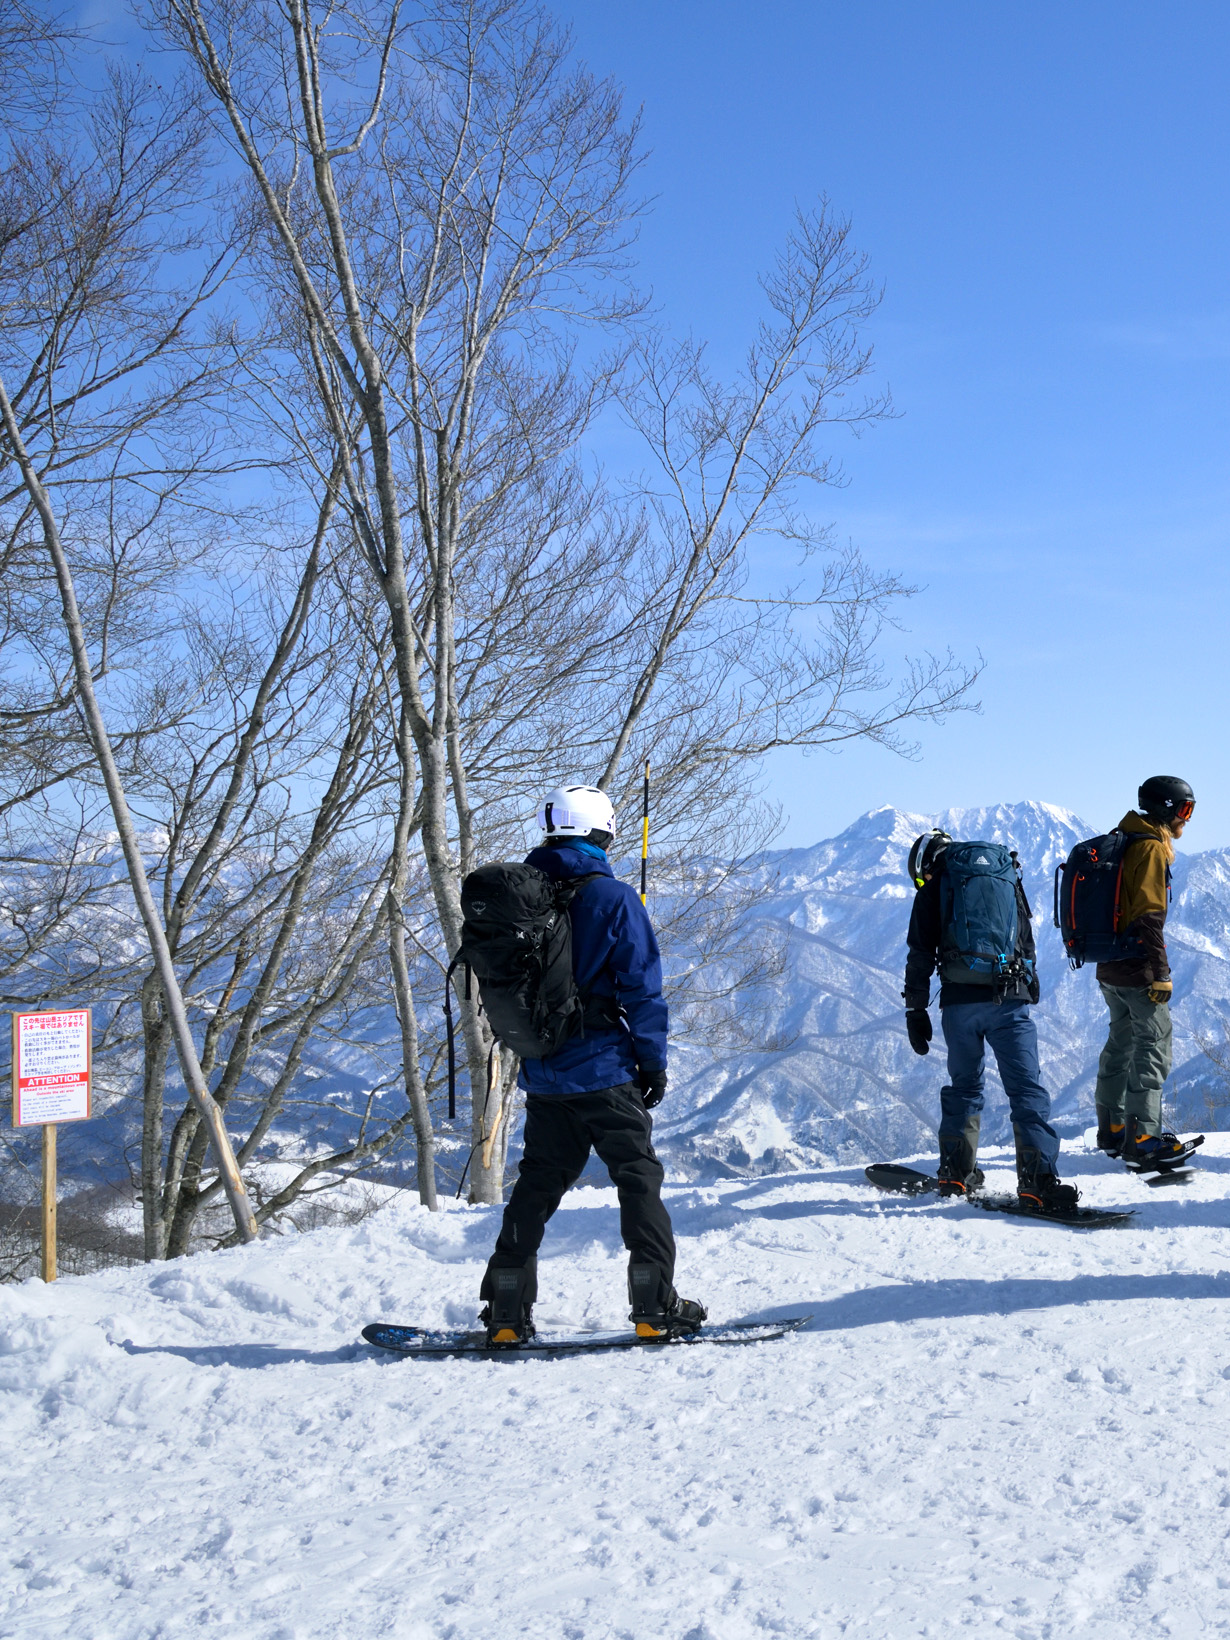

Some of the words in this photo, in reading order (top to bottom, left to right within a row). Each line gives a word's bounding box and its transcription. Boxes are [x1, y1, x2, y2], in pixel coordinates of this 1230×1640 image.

[24, 1021, 84, 1031] スキー場ではありません
[28, 1074, 80, 1086] ATTENTION
